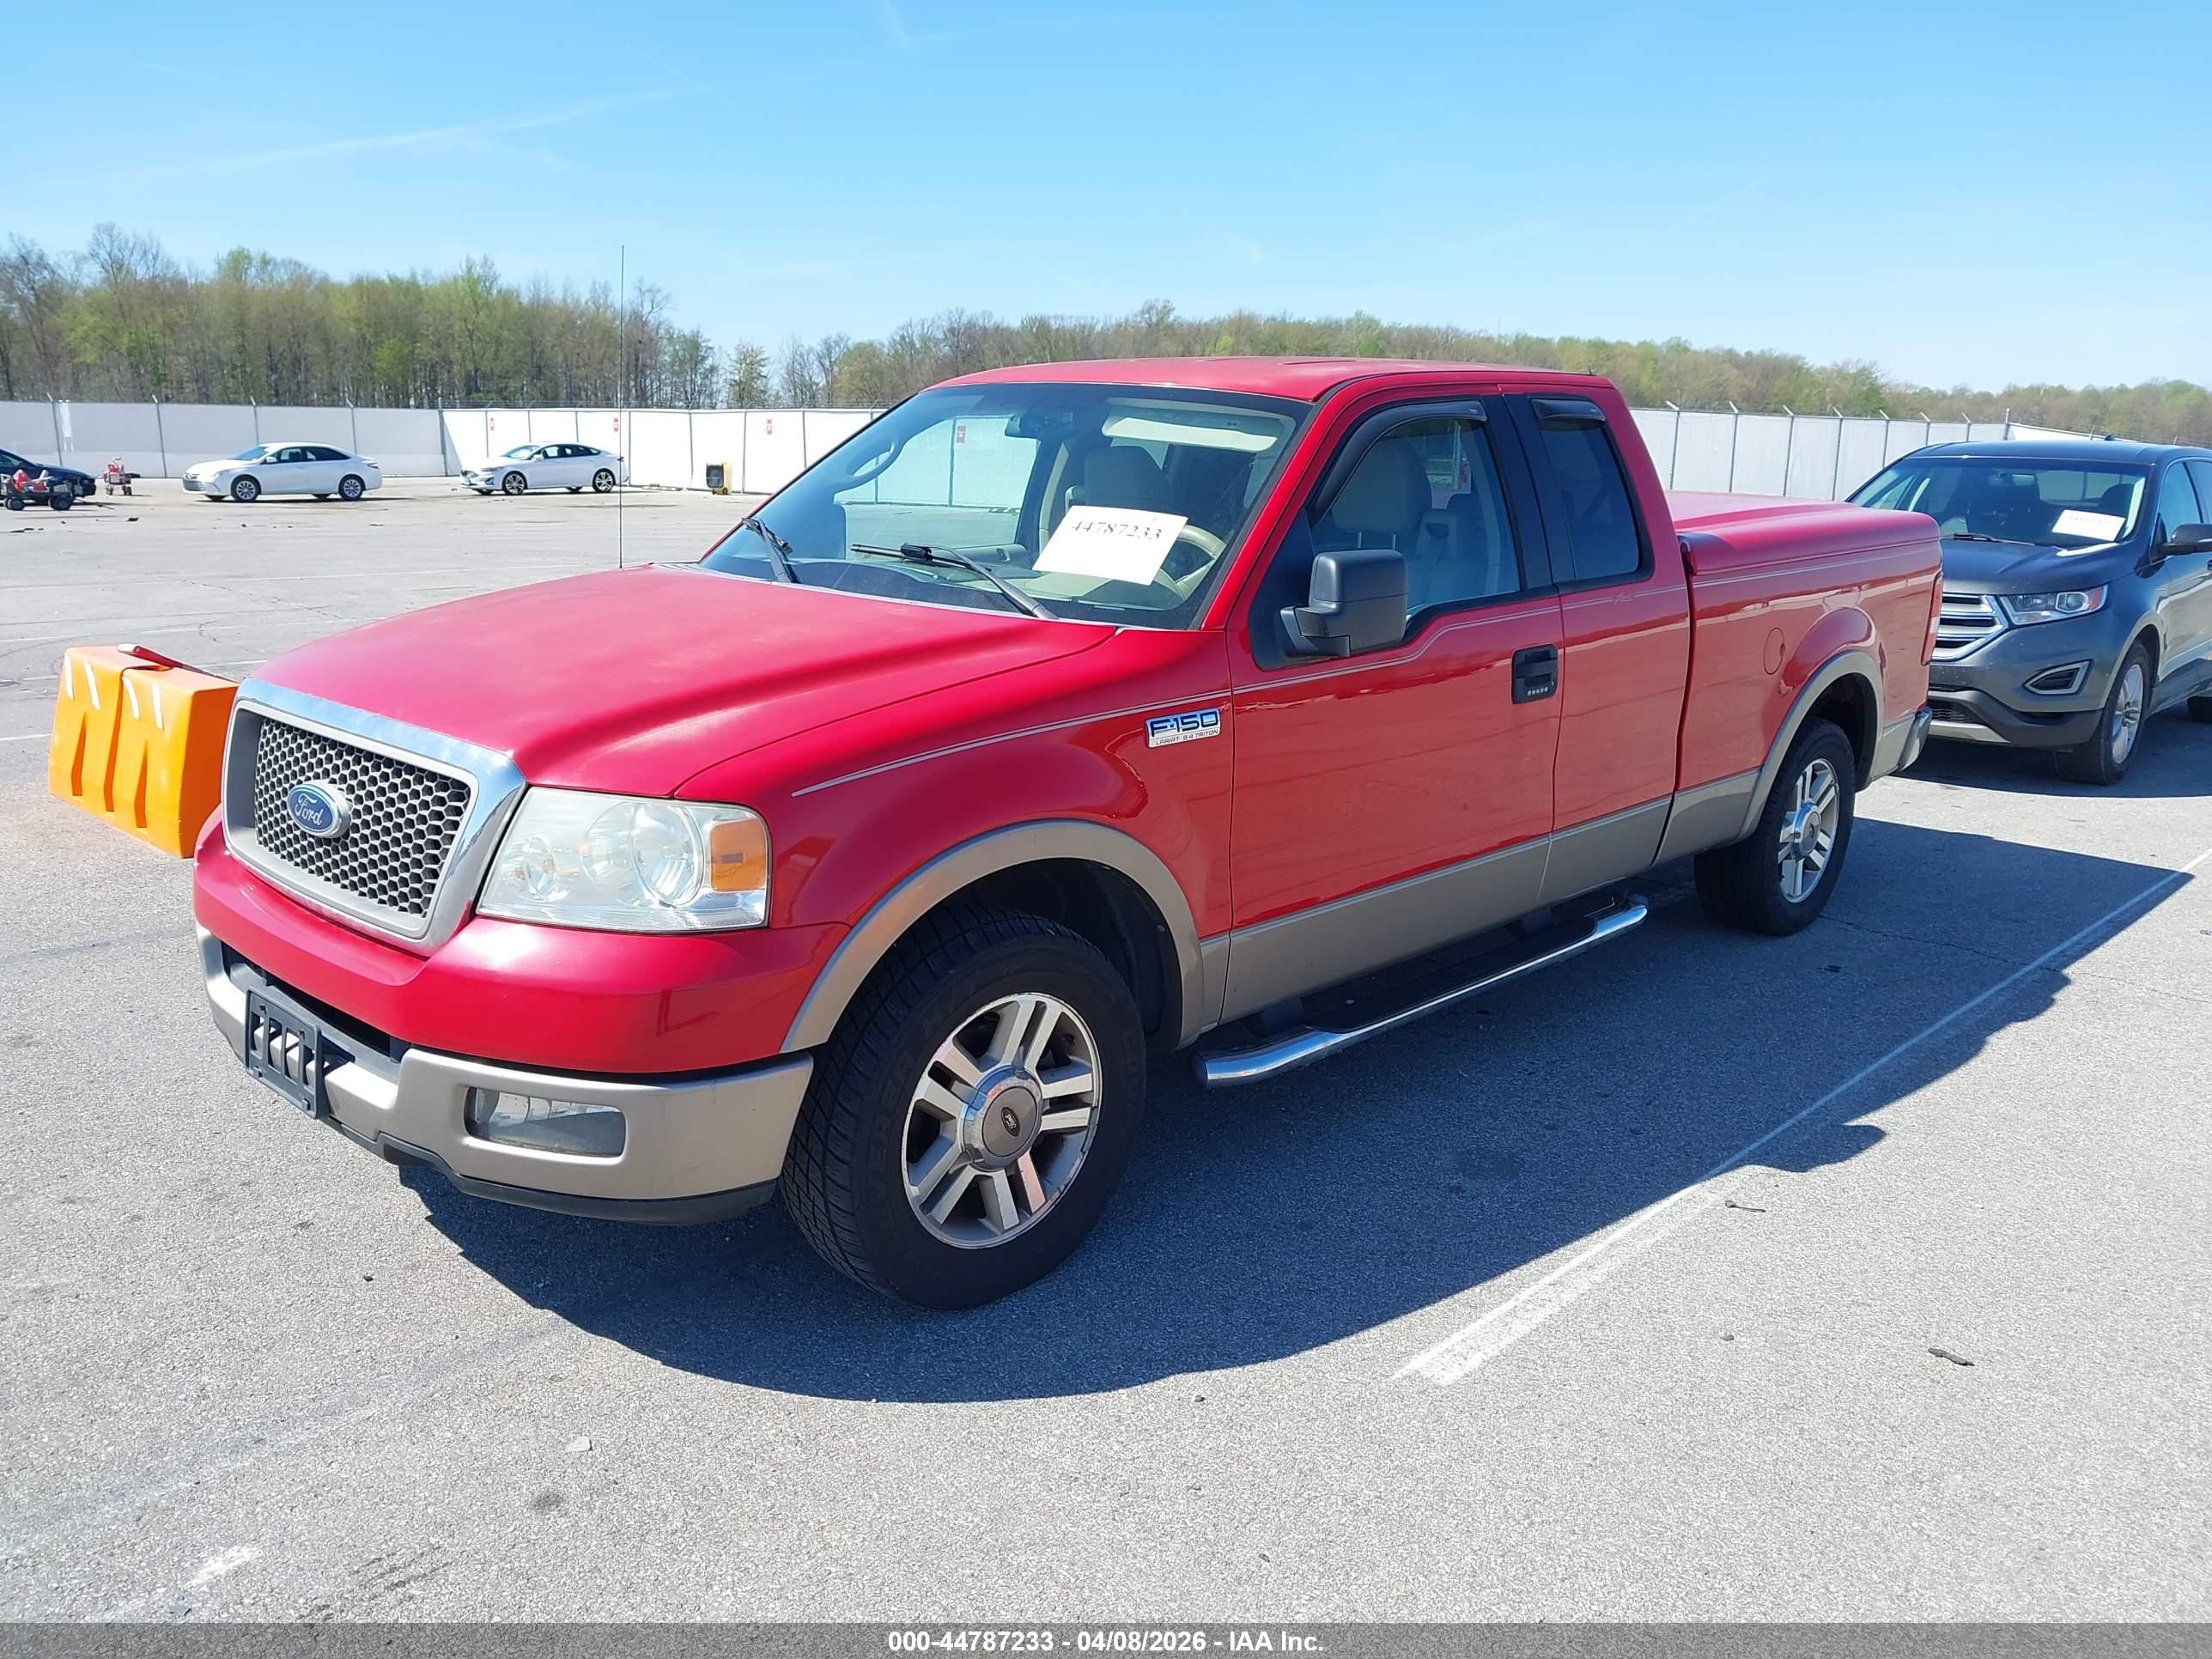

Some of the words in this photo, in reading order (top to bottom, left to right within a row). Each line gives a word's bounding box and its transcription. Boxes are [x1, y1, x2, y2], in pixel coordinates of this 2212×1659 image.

[1071, 520, 1162, 539] 44787233
[1156, 736, 1180, 745] LARIAT
[1194, 729, 1218, 738] TRITON
[295, 793, 324, 826] Ford
